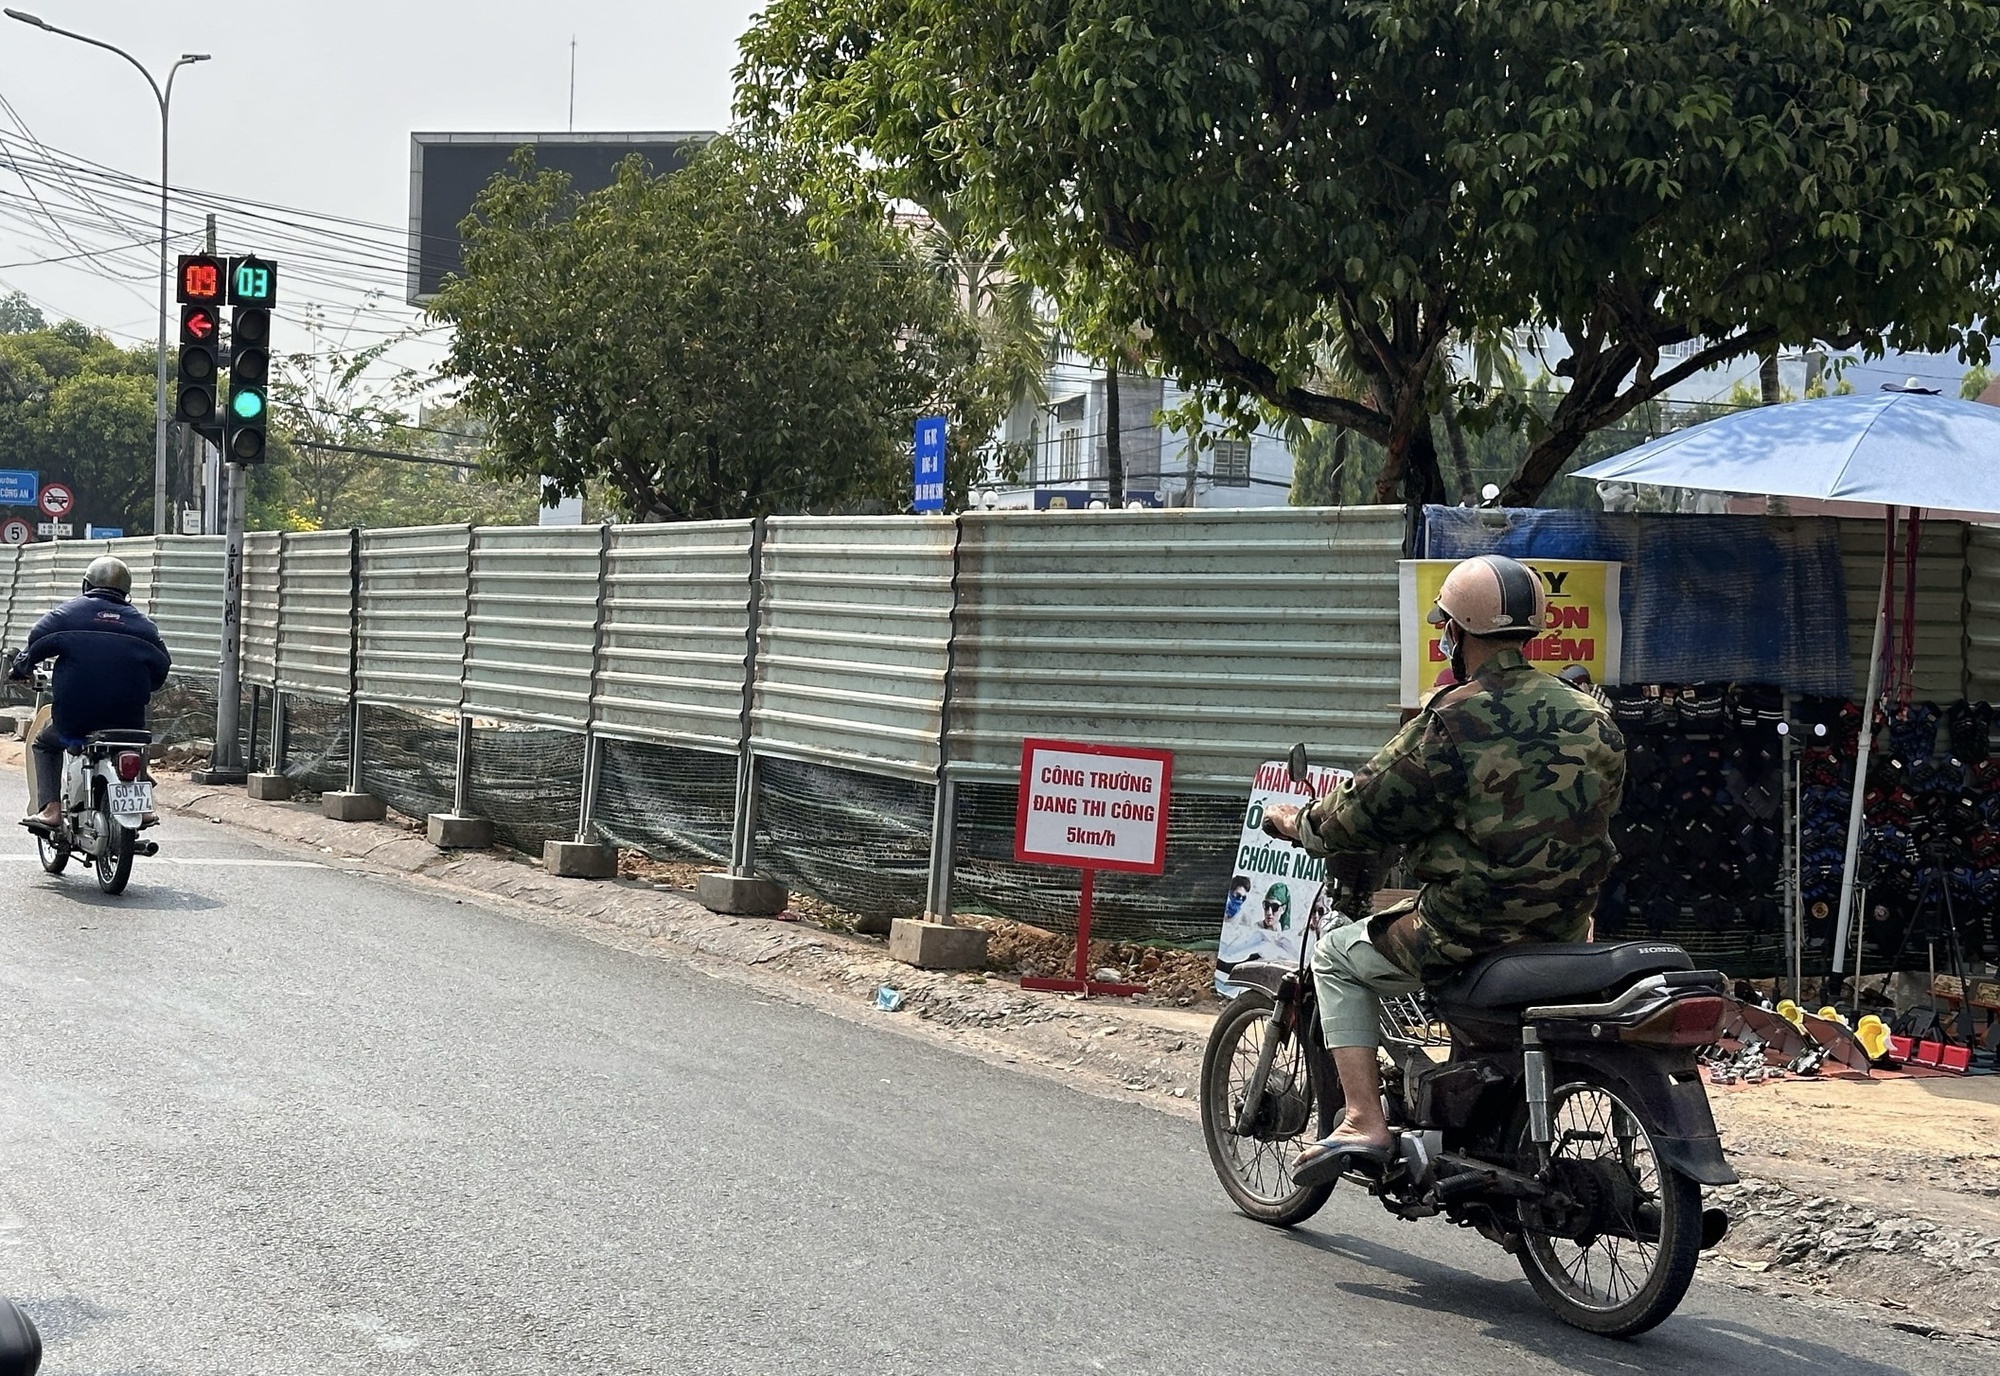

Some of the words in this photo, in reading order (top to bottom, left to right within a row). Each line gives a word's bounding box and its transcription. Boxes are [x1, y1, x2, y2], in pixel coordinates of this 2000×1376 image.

[186, 265, 217, 296] 09
[238, 267, 268, 298] 03
[1040, 764, 1085, 787] CÔNG
[1089, 770, 1152, 793] TRƯỜNG
[1254, 762, 1292, 793] KHĂN
[1033, 794, 1077, 815] ĐANG
[1082, 799, 1106, 817] THI
[1110, 800, 1155, 822] CÔNG
[1066, 826, 1116, 847] 5km/h
[1238, 840, 1291, 877] CHỐNG
[1638, 946, 1683, 954] HONDA
